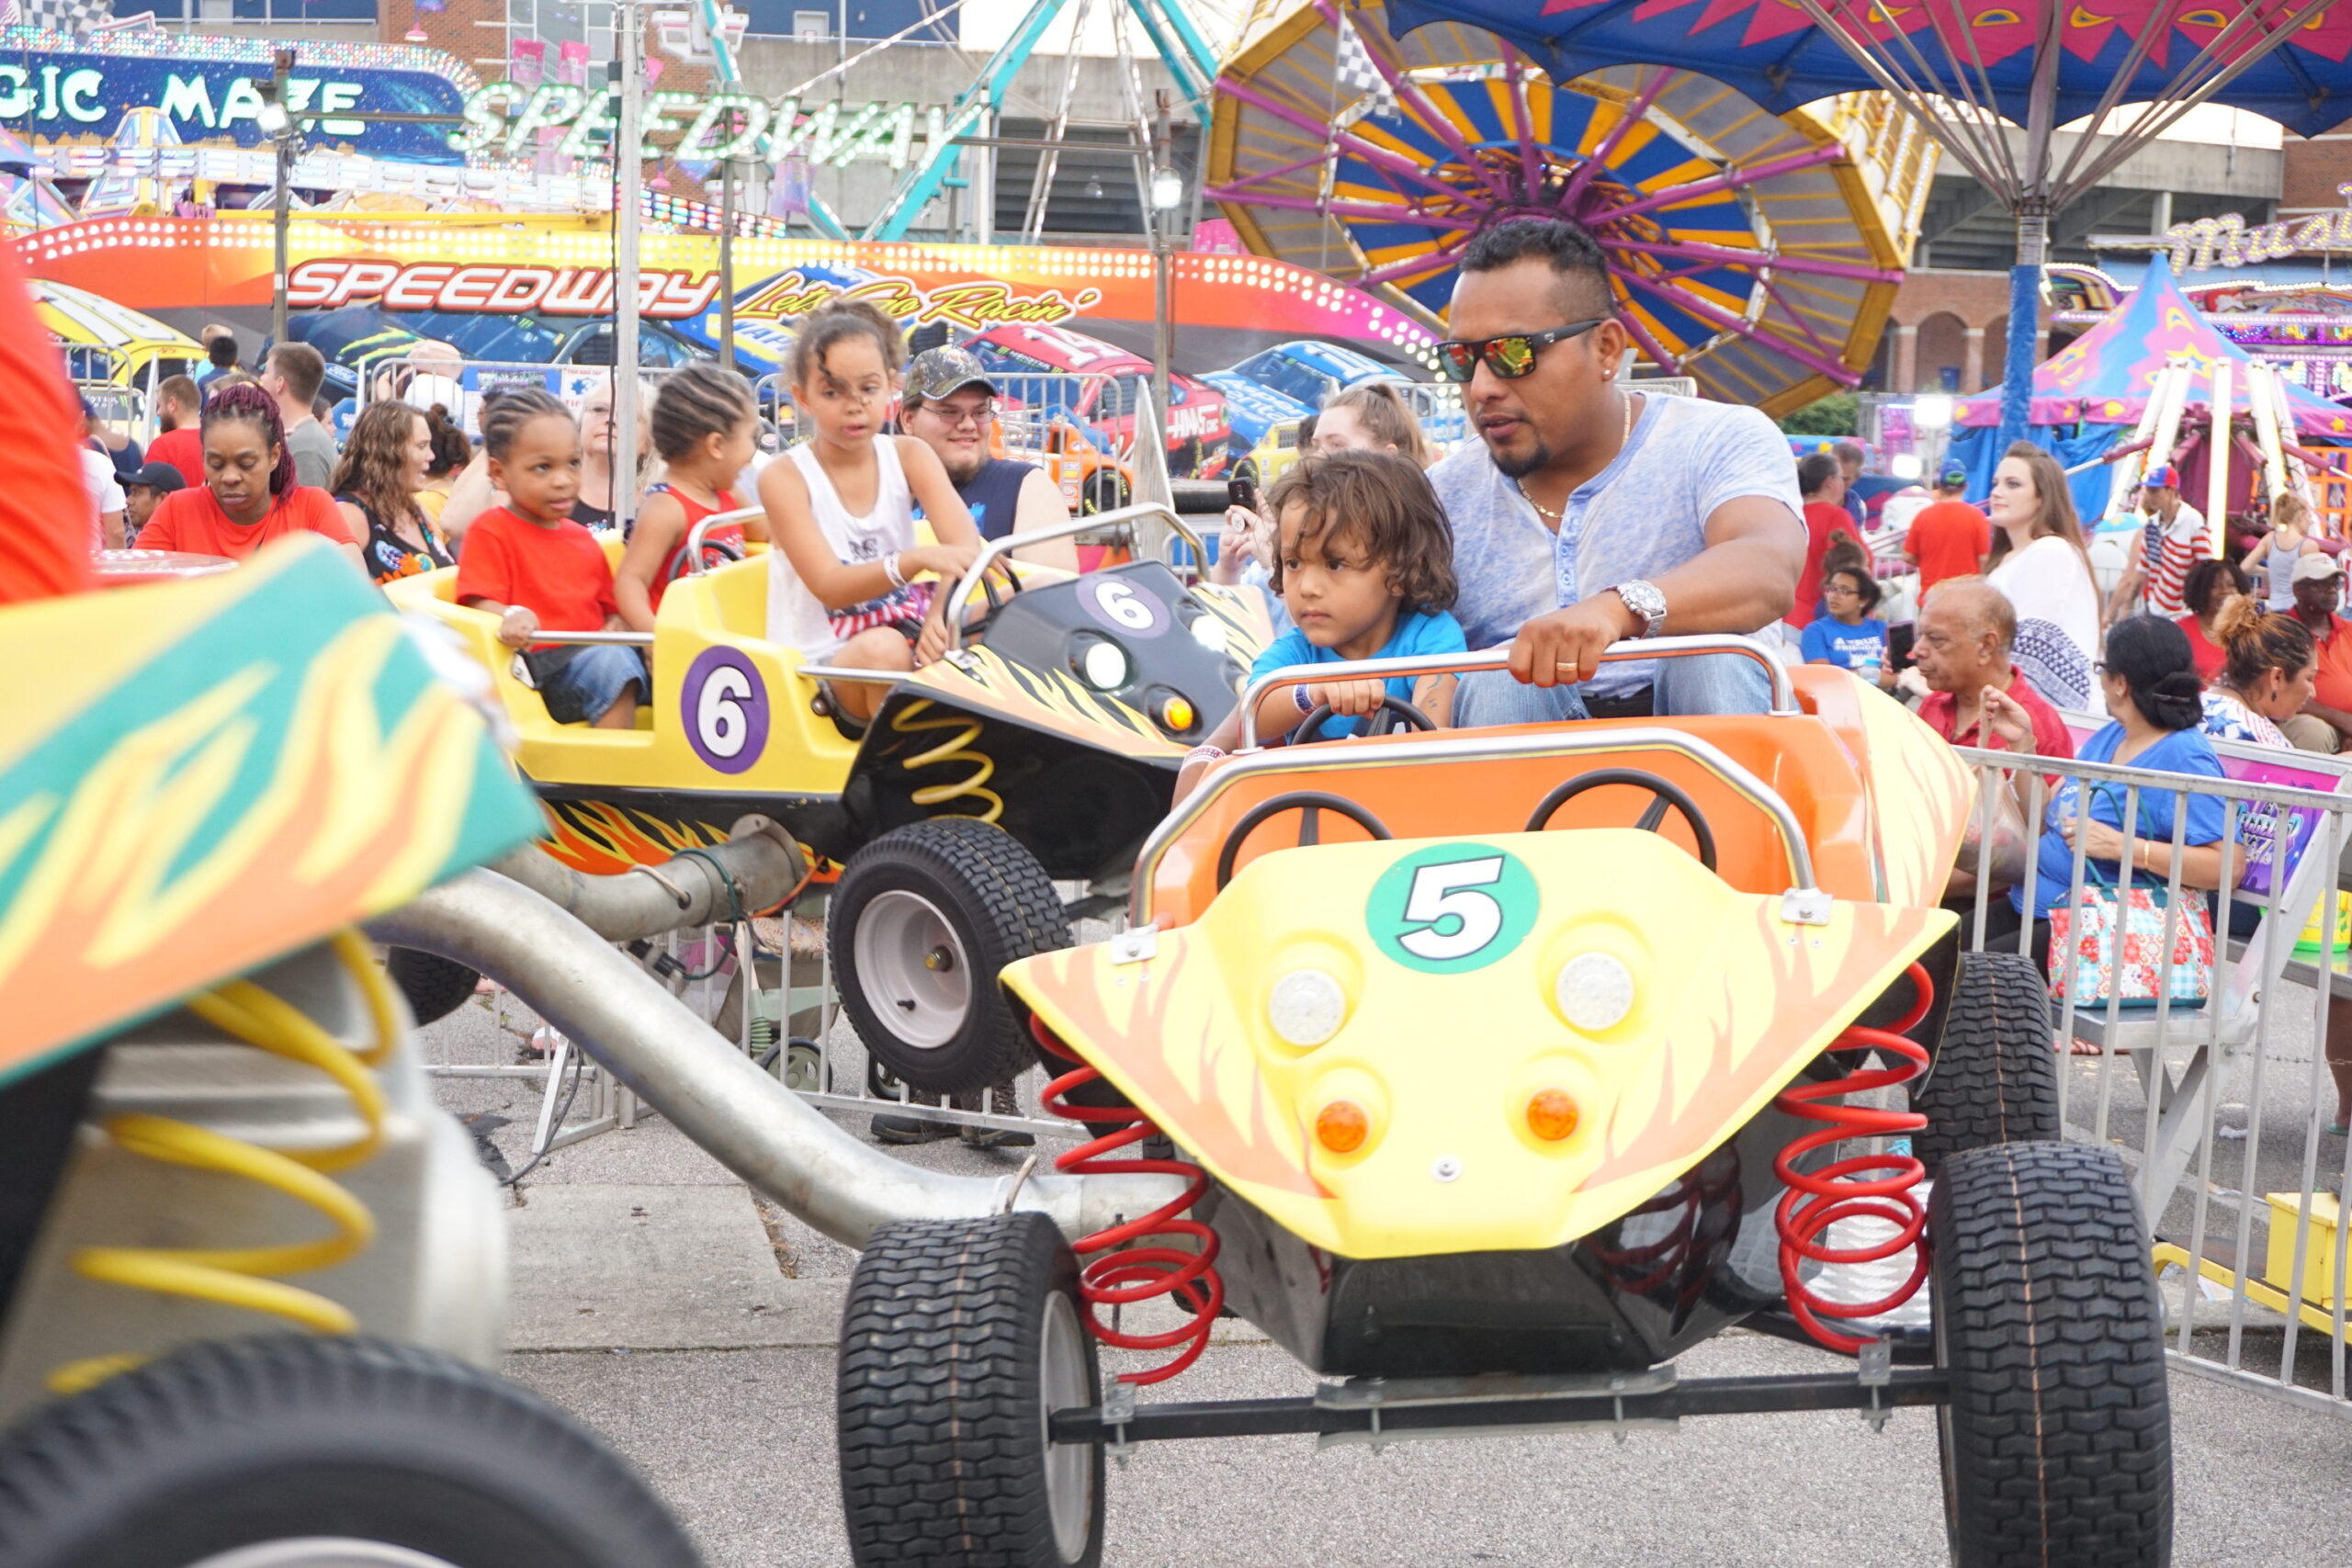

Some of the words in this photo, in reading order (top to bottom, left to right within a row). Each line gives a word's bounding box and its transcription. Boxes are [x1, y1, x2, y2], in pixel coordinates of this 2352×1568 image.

[447, 82, 990, 171] SPEEDWAY
[287, 259, 721, 318] SPEEDWAY
[1095, 581, 1155, 630] 6
[696, 655, 753, 760] 6
[1395, 854, 1506, 961] 5
